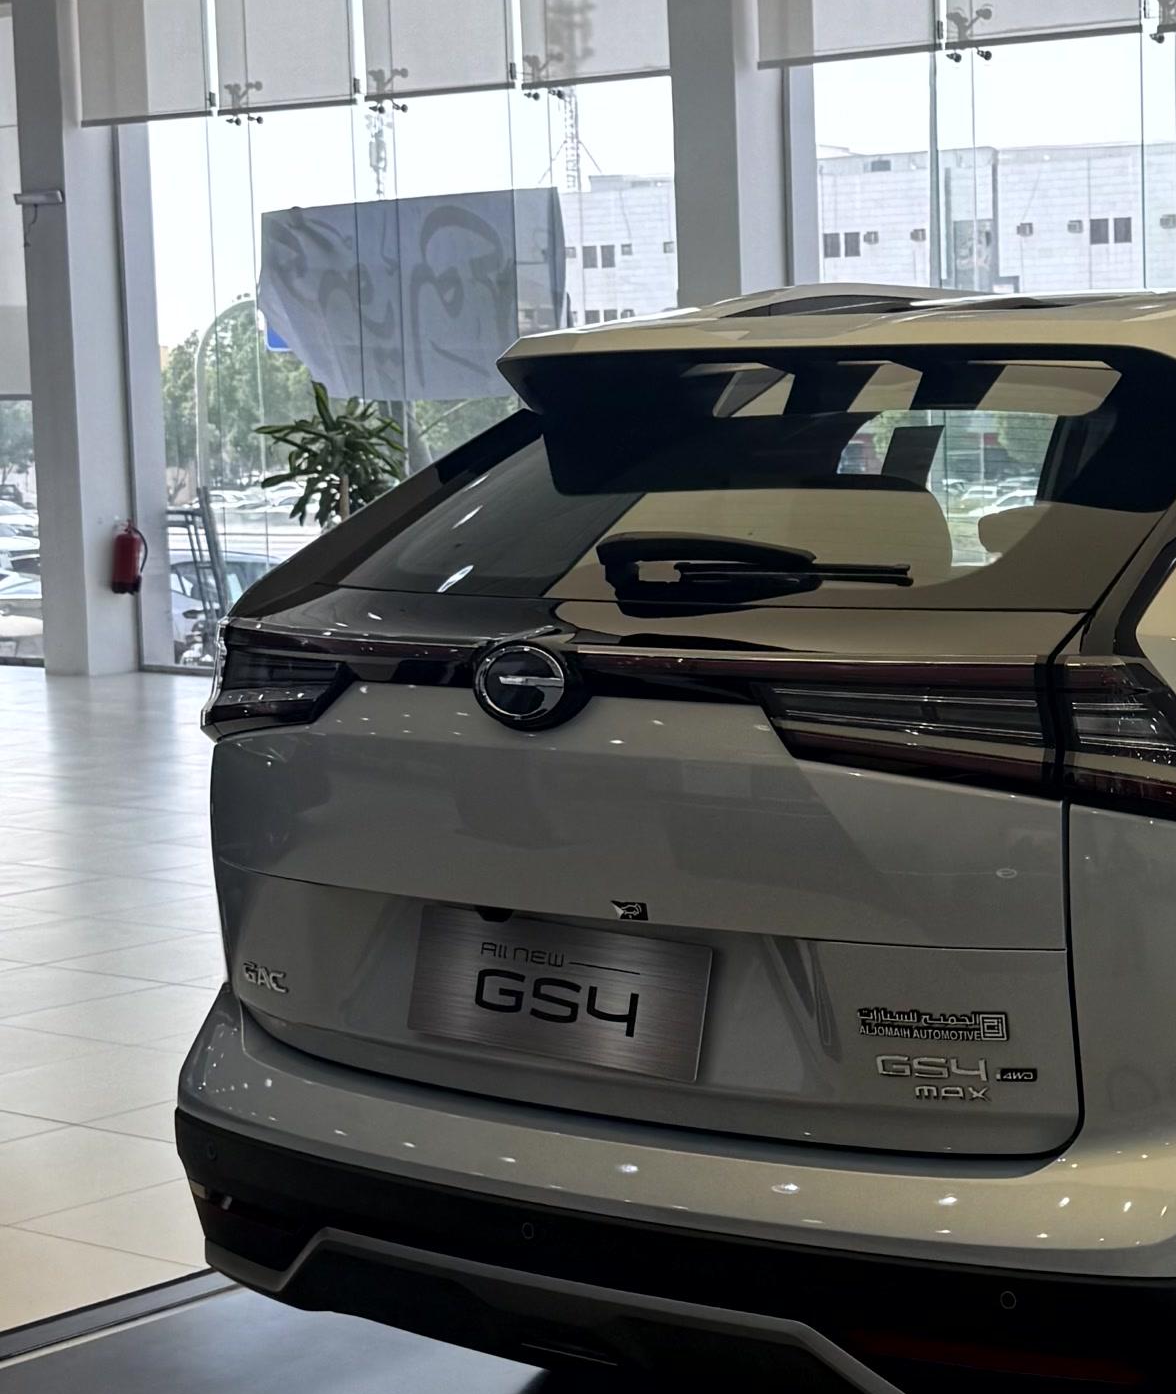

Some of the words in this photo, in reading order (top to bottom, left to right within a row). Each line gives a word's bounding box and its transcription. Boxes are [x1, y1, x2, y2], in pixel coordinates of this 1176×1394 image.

[481, 942, 507, 959] All
[243, 961, 288, 993] GAC
[475, 968, 639, 1038] GS4
[912, 1028, 981, 1042] AUTOMOTIVE
[876, 1055, 988, 1081] GS4
[1001, 1069, 1035, 1081] 4WD
